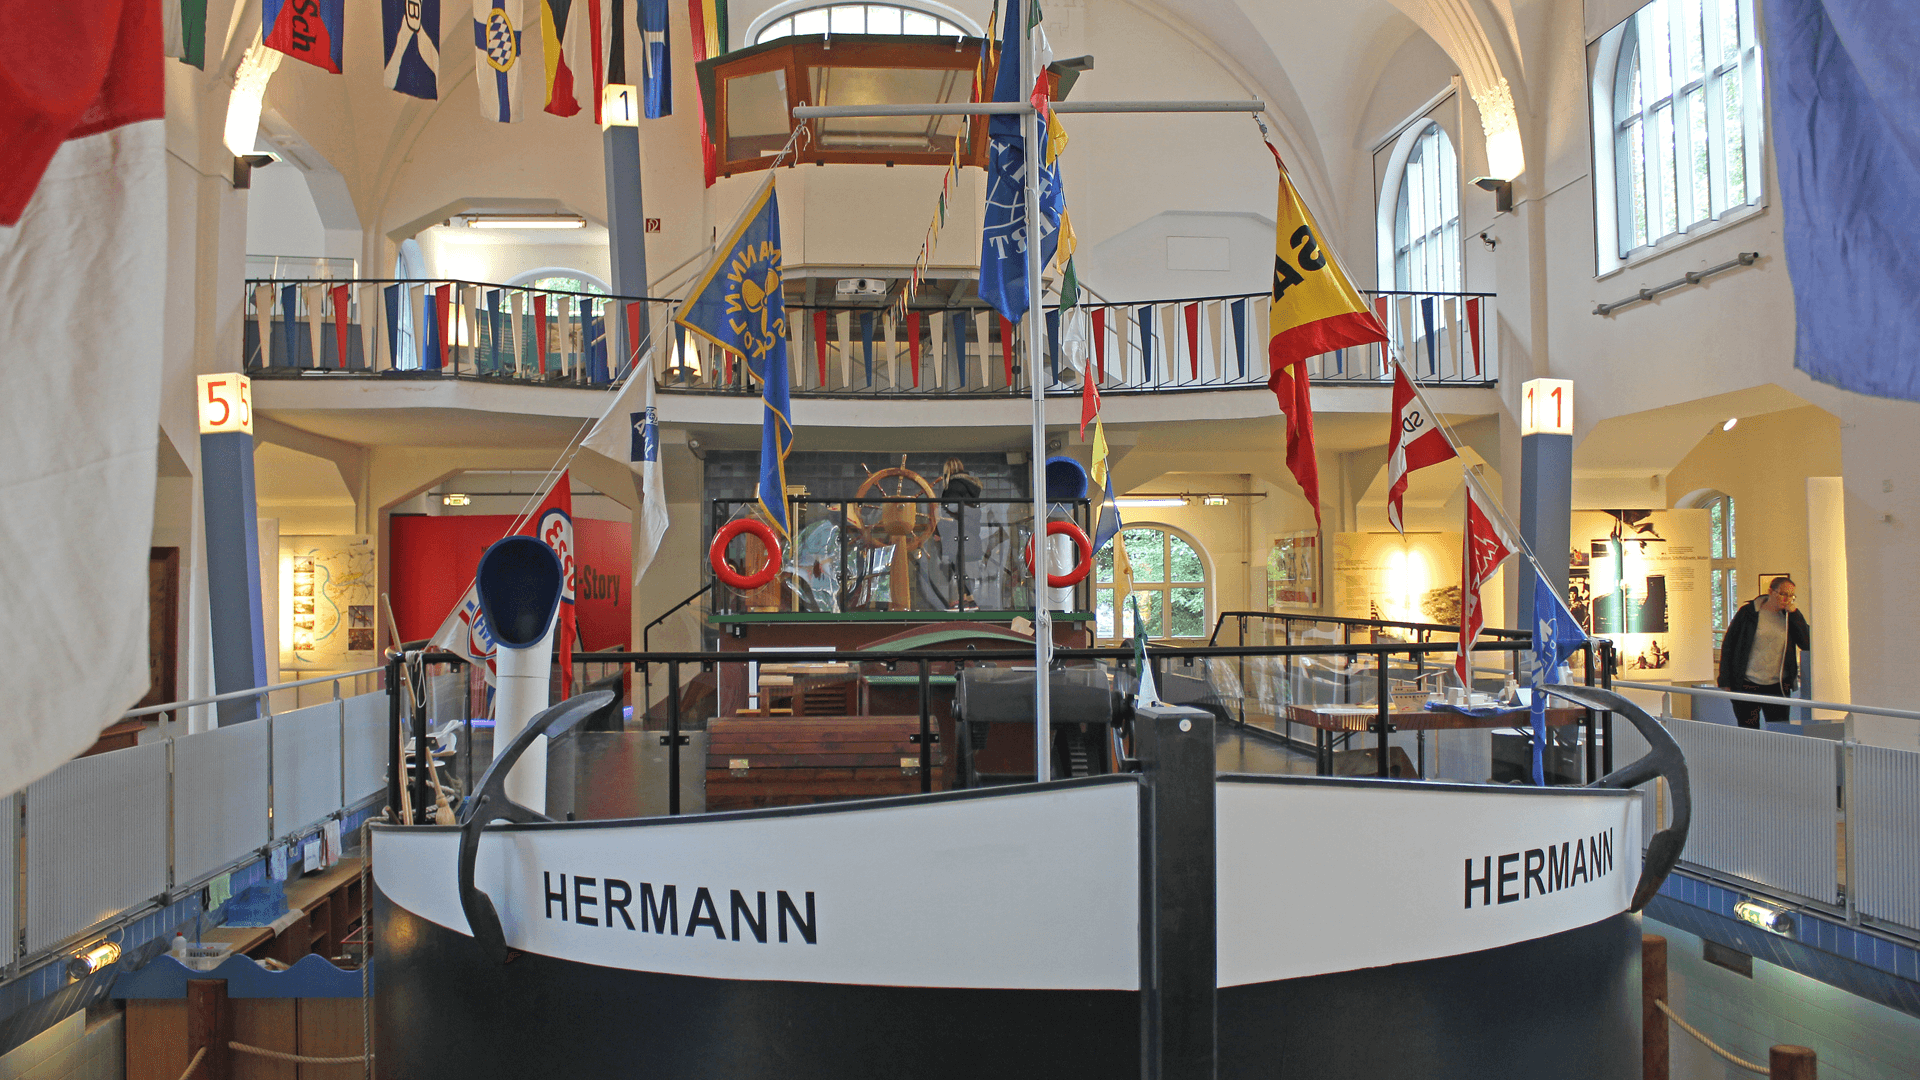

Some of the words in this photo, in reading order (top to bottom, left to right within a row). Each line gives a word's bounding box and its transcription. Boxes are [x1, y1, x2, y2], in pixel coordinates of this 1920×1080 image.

[619, 90, 629, 121] 1
[207, 381, 230, 426] 5
[1550, 386, 1562, 428] 1
[1464, 826, 1613, 910] HERMANN
[543, 870, 818, 945] HERMANN
